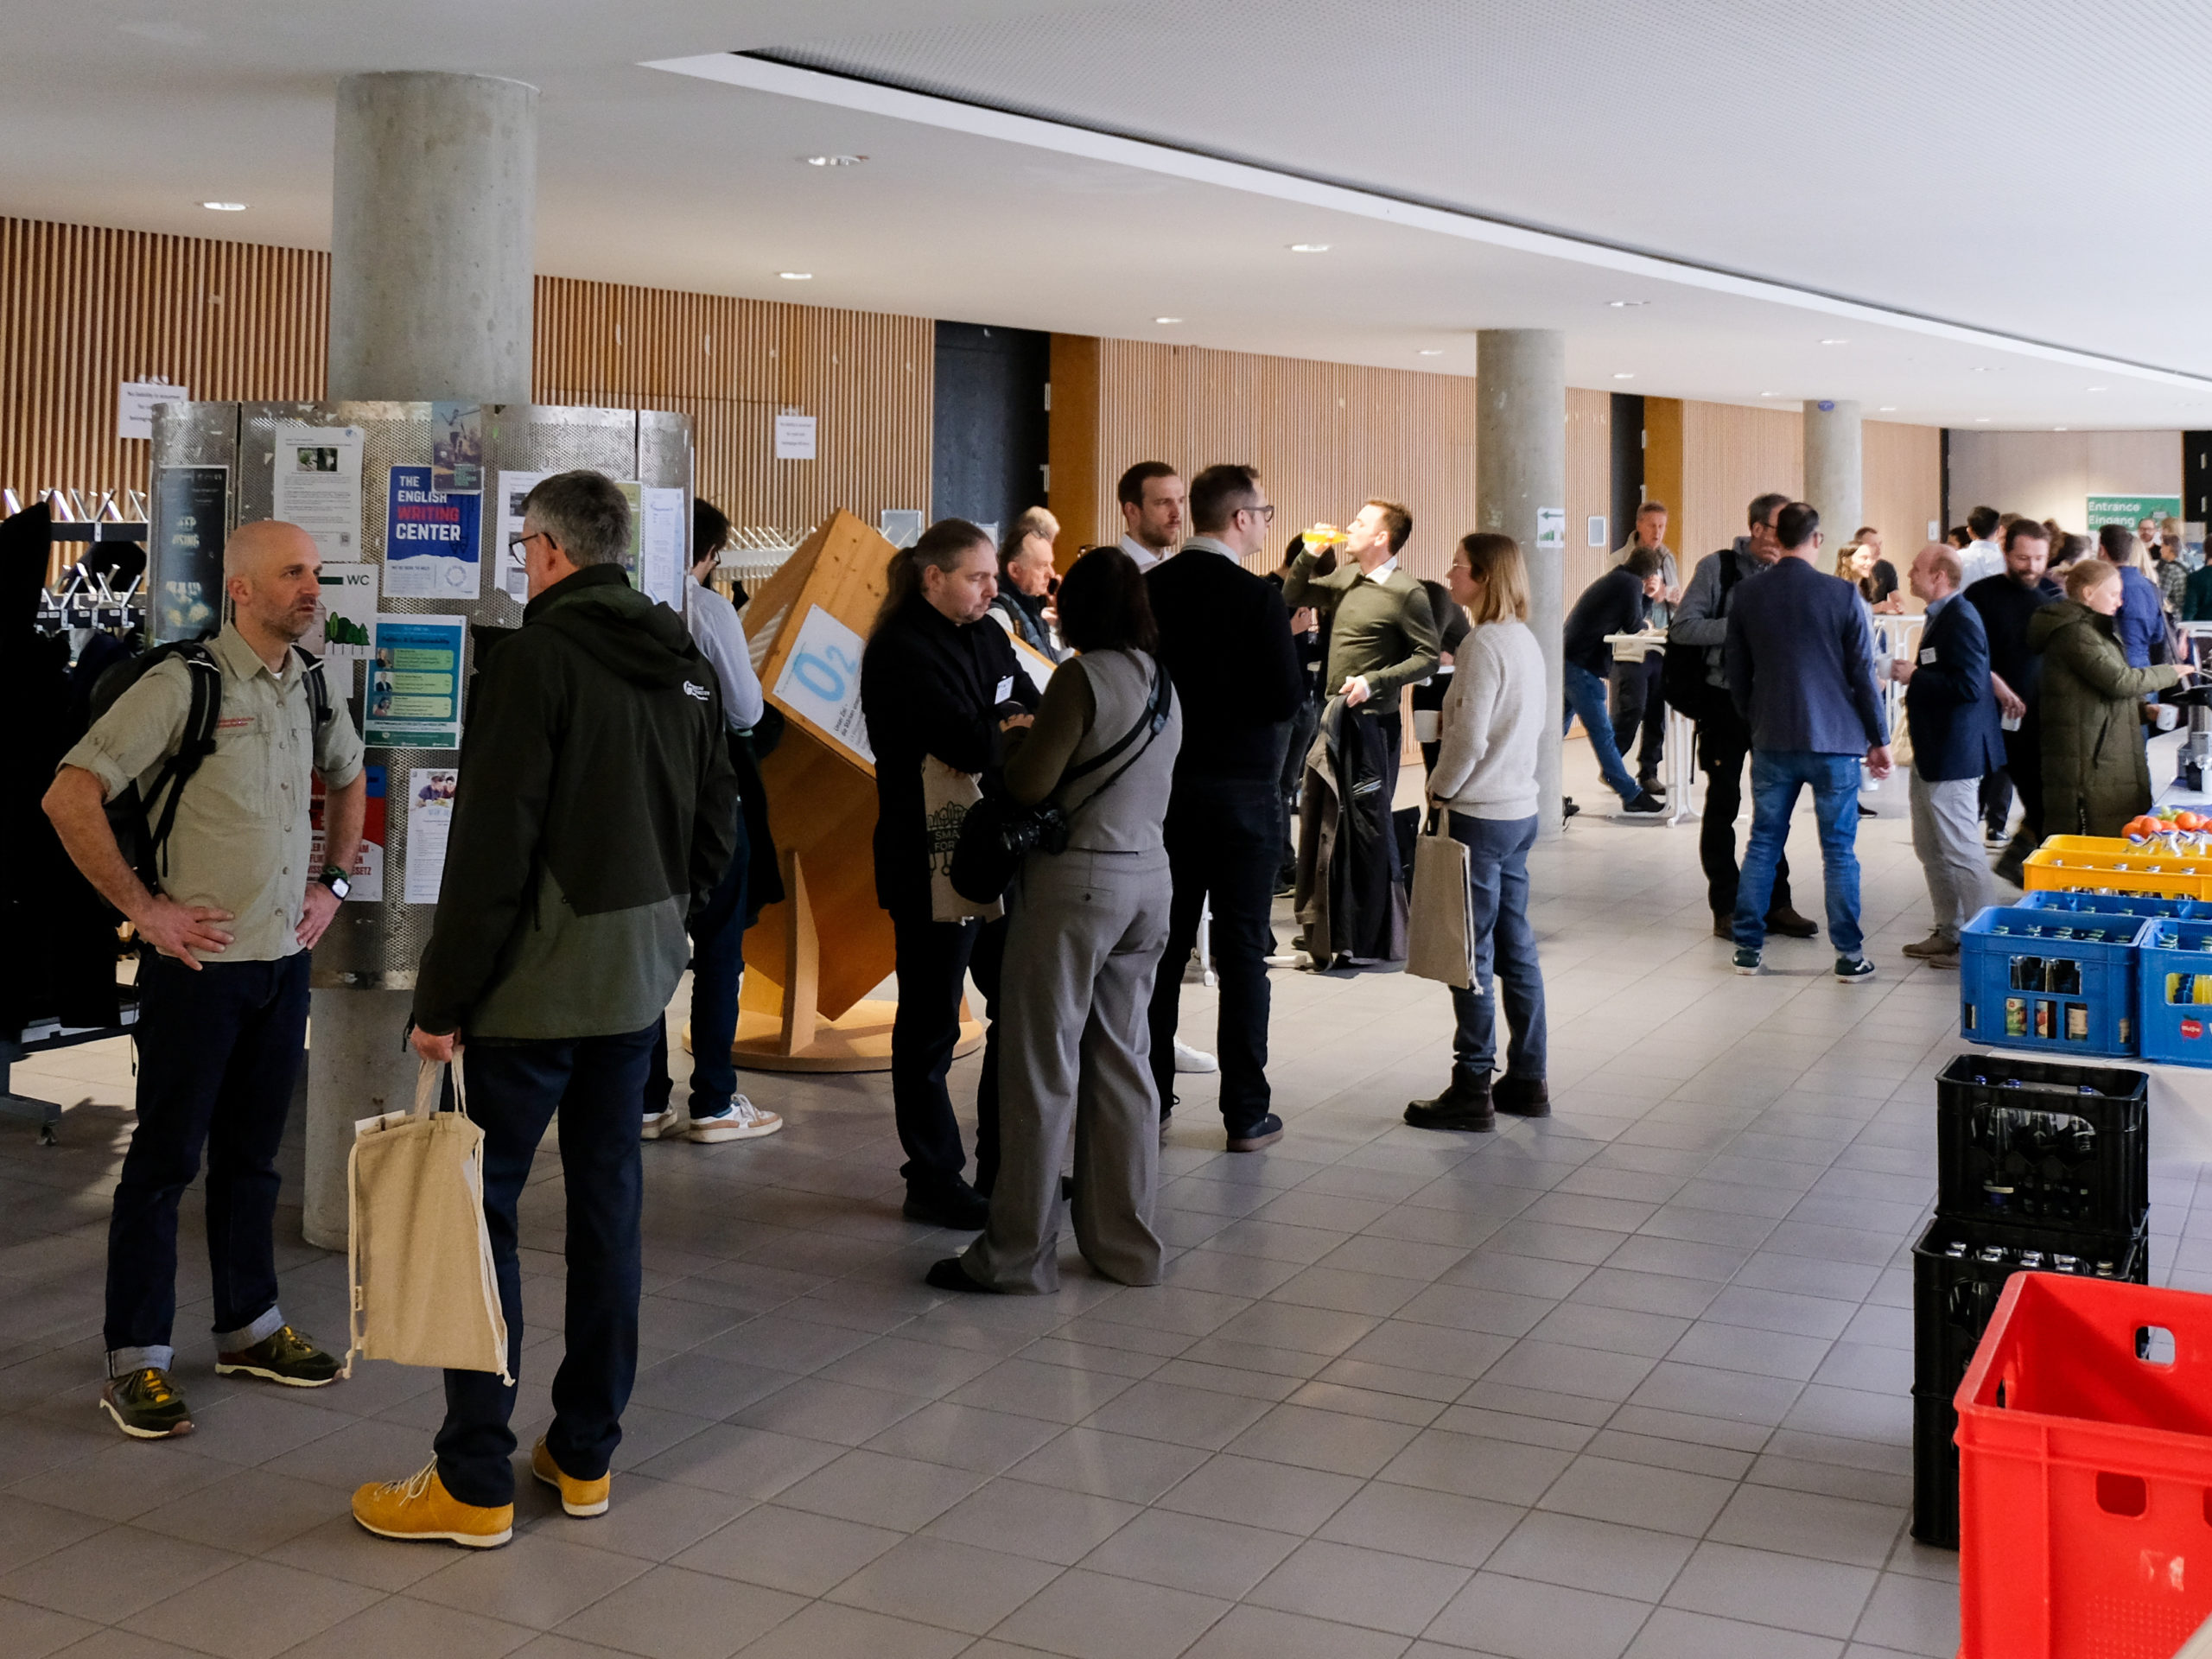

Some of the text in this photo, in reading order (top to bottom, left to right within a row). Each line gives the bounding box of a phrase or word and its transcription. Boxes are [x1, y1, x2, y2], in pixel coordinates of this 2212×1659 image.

[399, 475, 420, 487] THE
[397, 490, 448, 504] ENGLISH
[2088, 500, 2141, 512] Entrance
[397, 506, 461, 522] WRITING
[2088, 515, 2135, 528] Eingang
[396, 523, 461, 542] CENTER
[346, 575, 370, 586] WC
[934, 830, 961, 841] SMA
[934, 841, 956, 852] FOR
[353, 867, 372, 875] ESETZ
